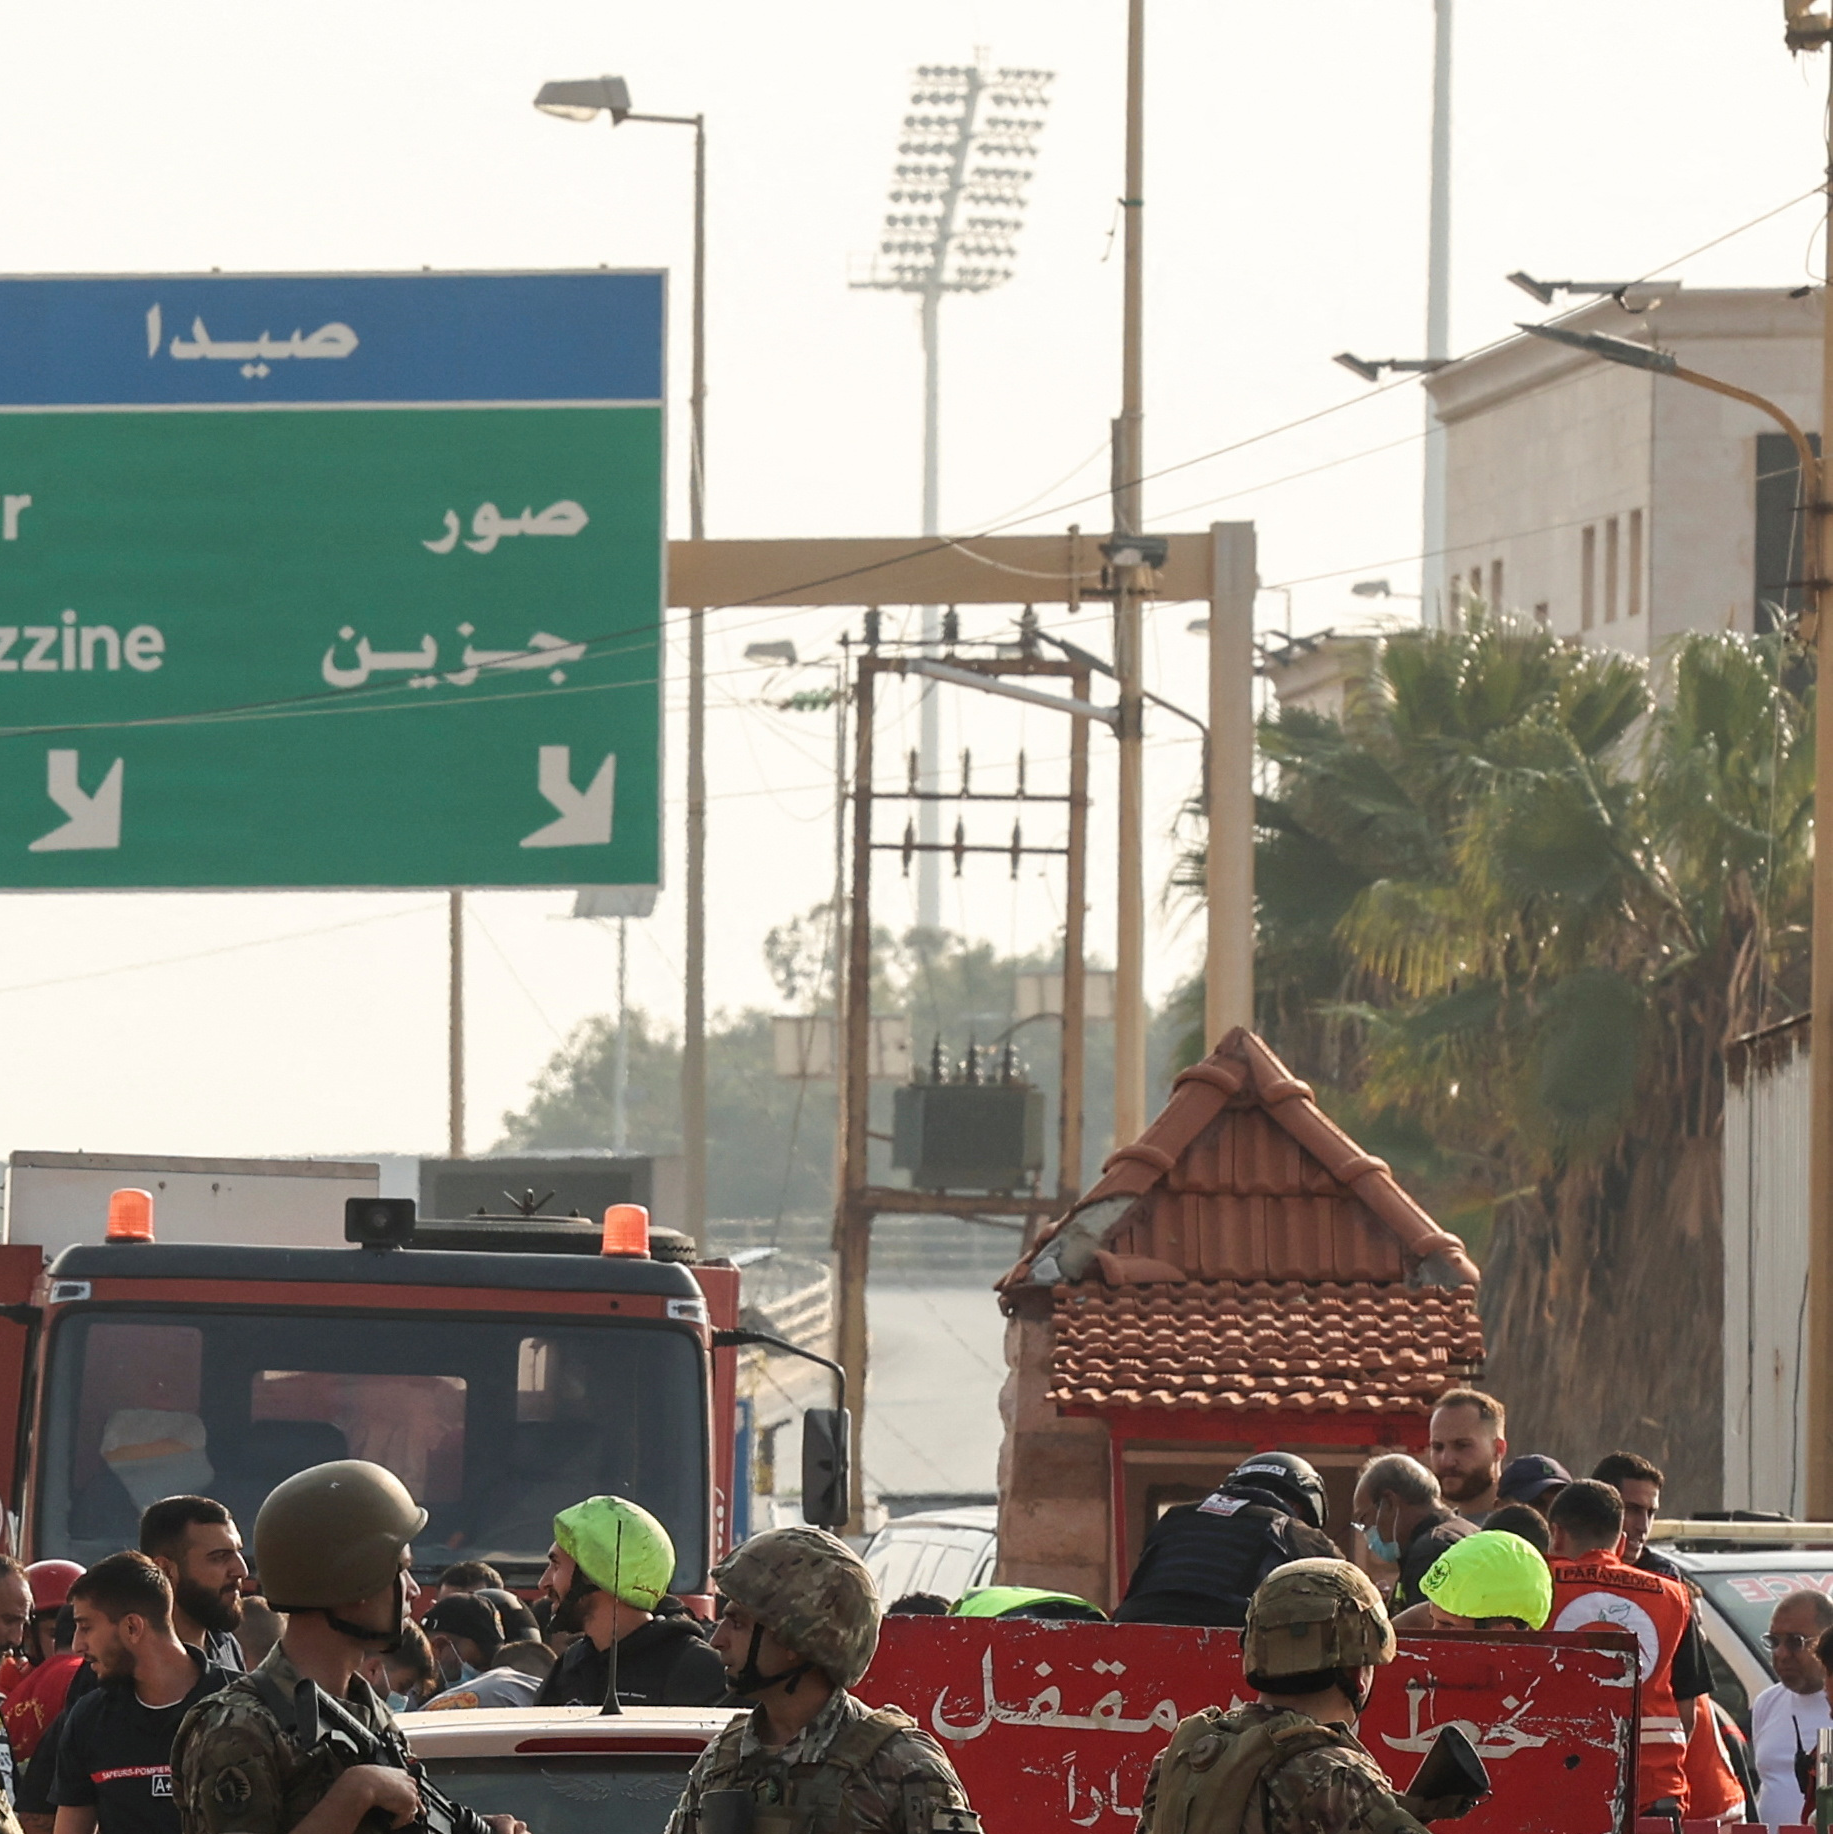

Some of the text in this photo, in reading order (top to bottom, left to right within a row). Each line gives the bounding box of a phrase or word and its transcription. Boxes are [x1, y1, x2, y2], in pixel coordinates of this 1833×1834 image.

[146, 303, 360, 379] صيدا
[422, 499, 590, 554] صور
[321, 622, 587, 690] جزين
[931, 1644, 1178, 1741] مقفل
[101, 1765, 172, 1780] SAPEURS-POMPIER
